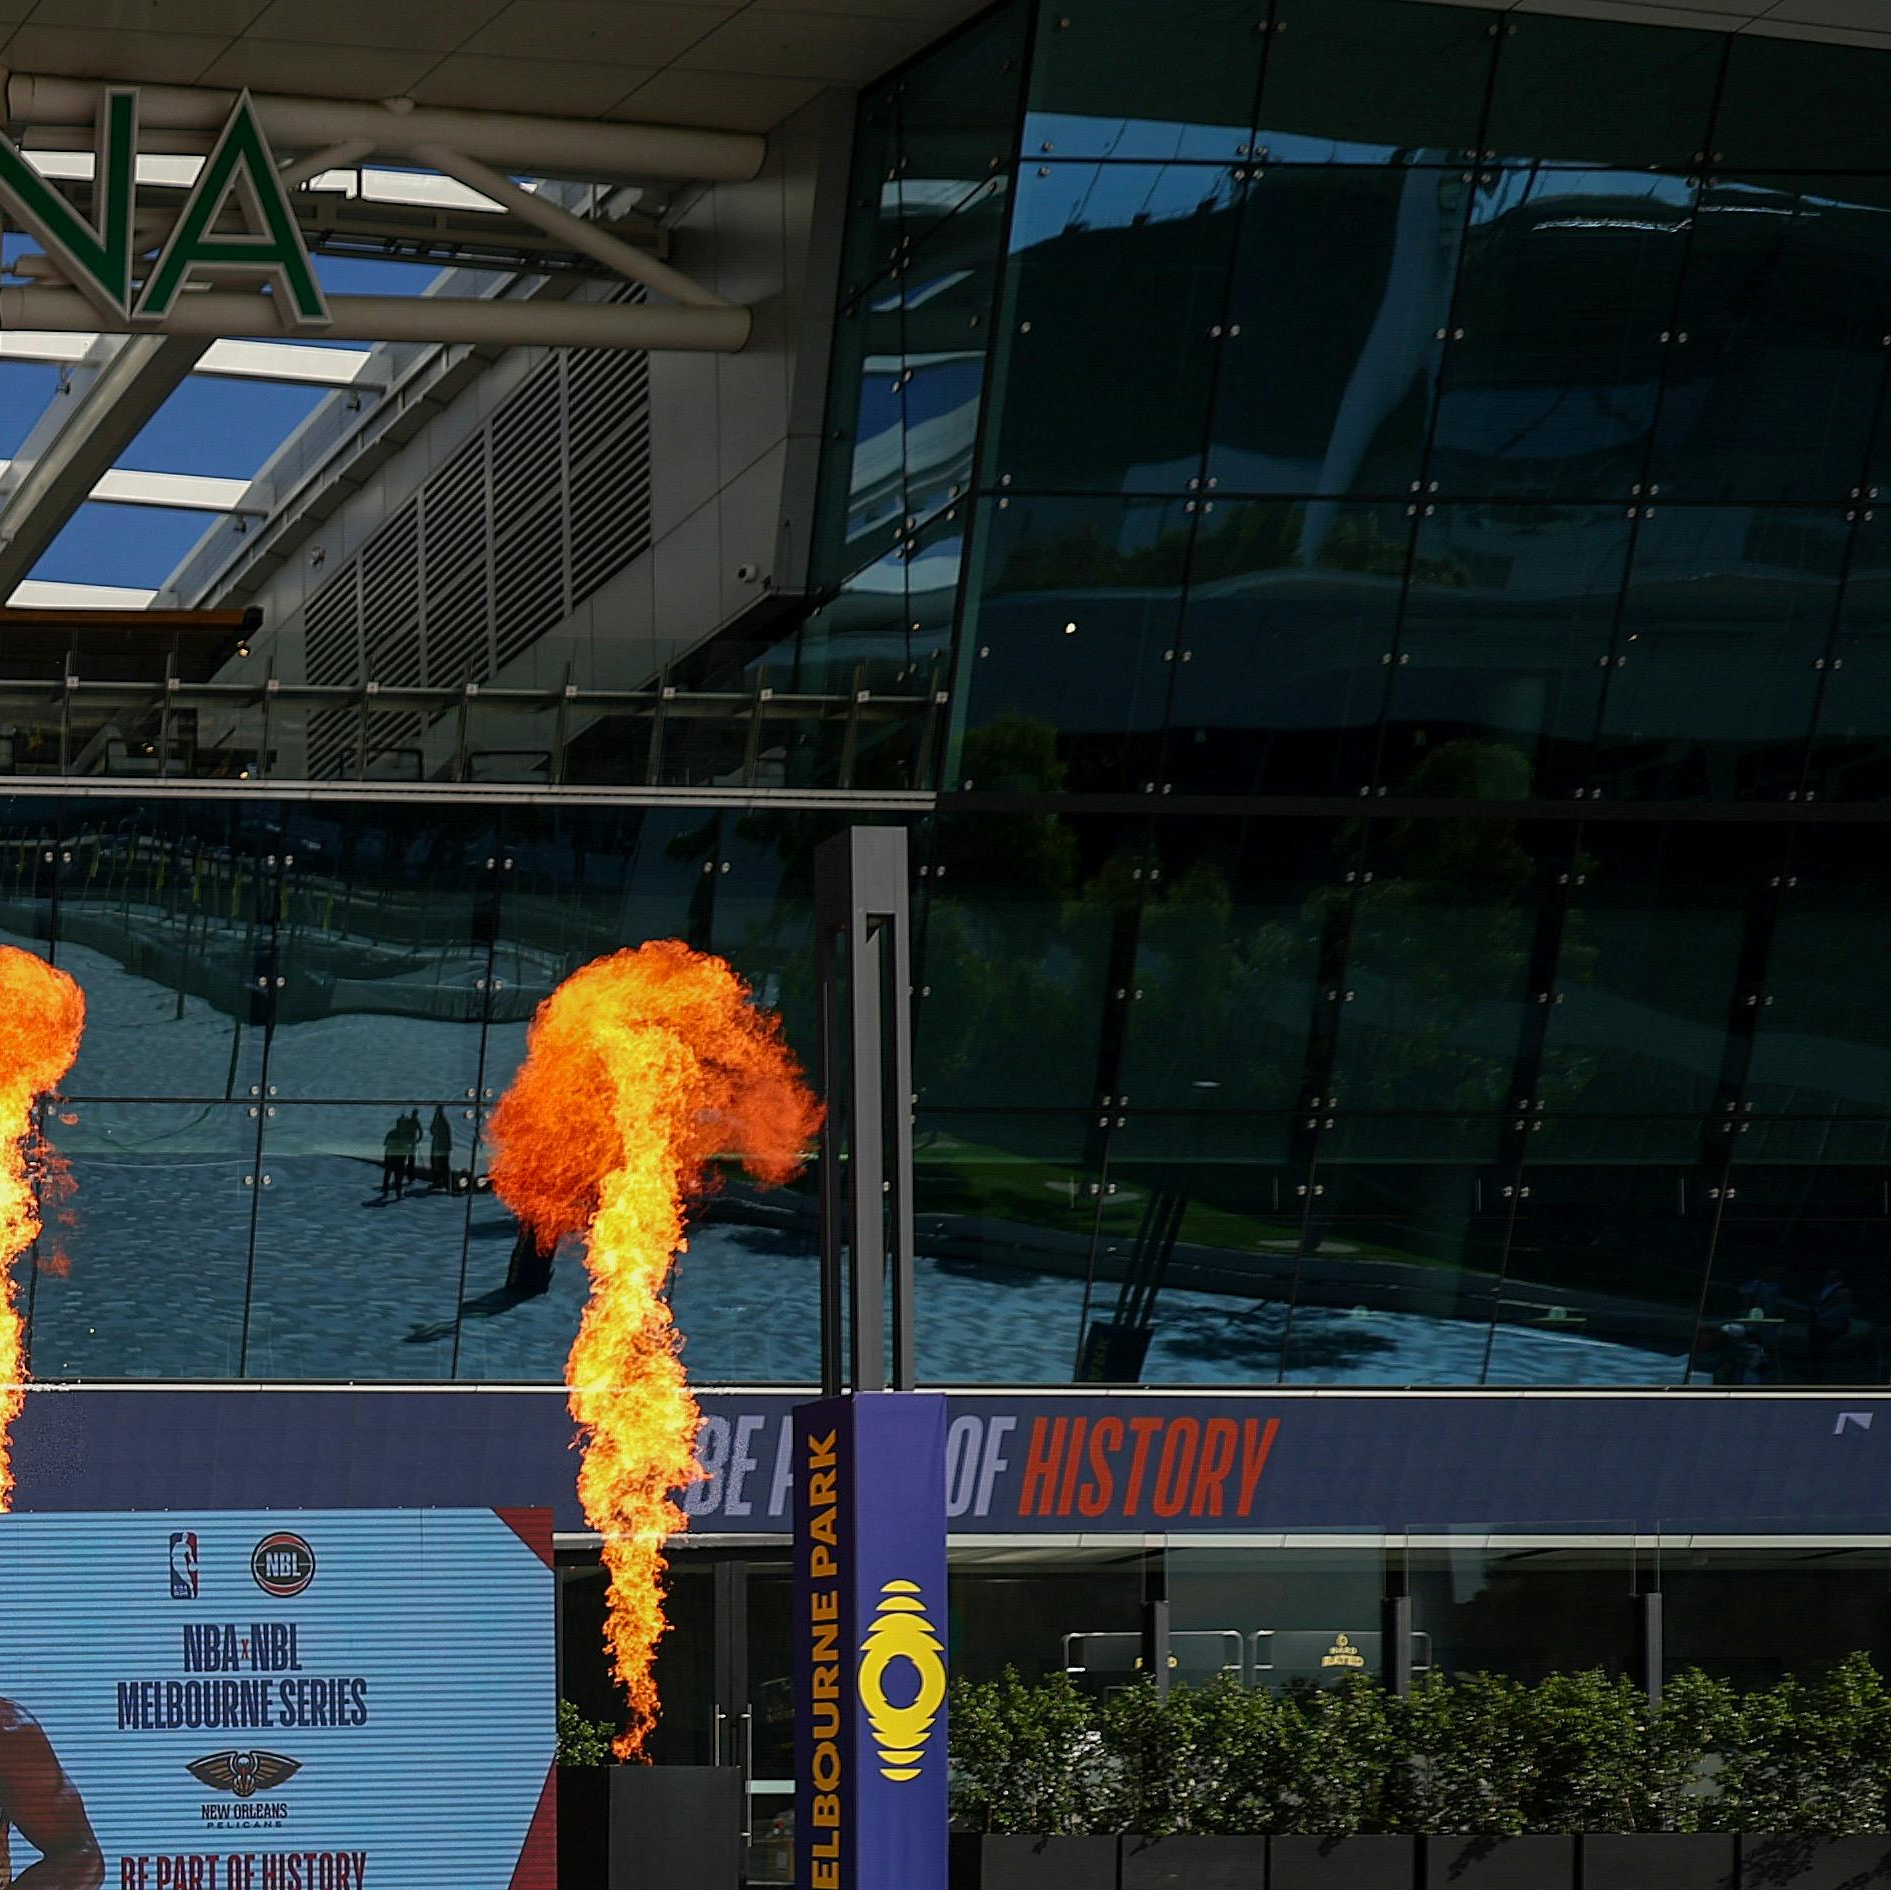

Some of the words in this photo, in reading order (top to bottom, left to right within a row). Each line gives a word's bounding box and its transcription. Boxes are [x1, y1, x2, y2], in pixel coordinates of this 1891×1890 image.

[1018, 1416, 1281, 1518] HISTORY
[807, 1428, 838, 1578] PARK
[265, 1551, 302, 1578] NBL
[183, 1624, 240, 1673] NBA
[250, 1623, 302, 1671] NBL
[118, 1679, 274, 1730] MELBOURNE
[279, 1678, 368, 1727] SERIES
[201, 1803, 230, 1820] NEW
[234, 1803, 288, 1819] ORLEANS
[207, 1820, 282, 1829] PELICANS
